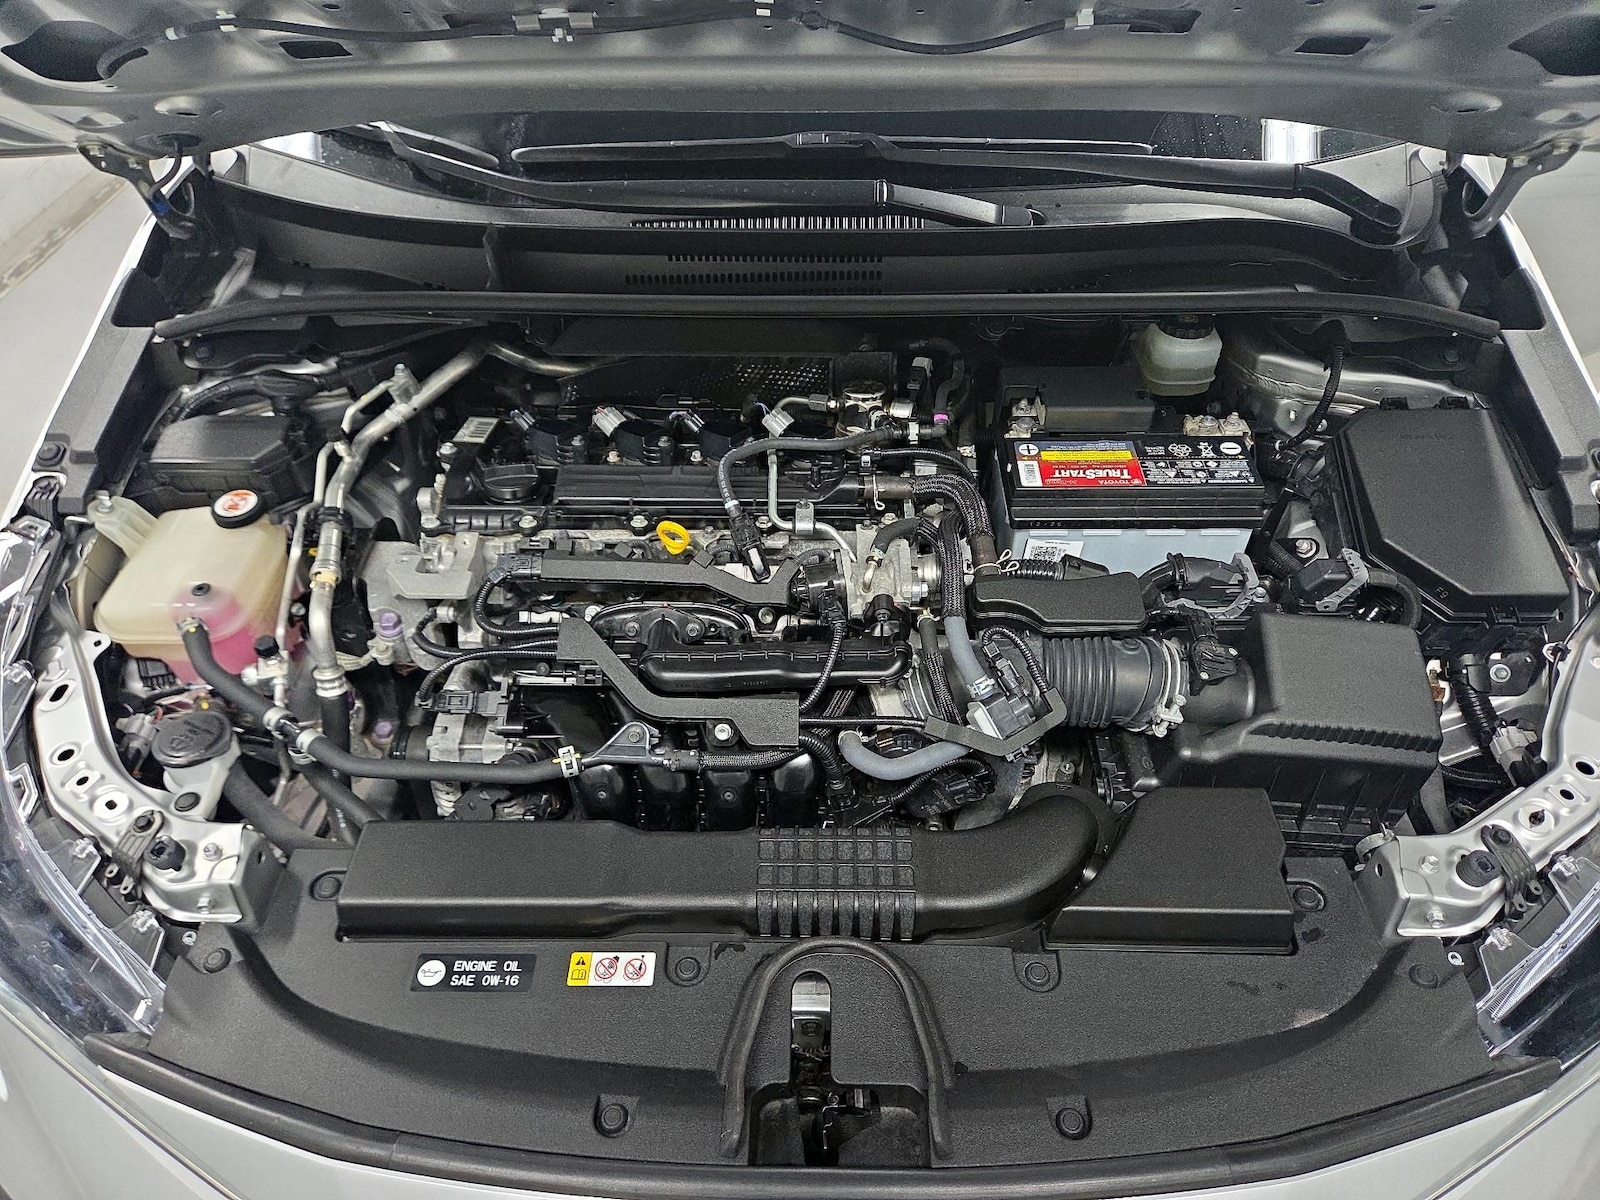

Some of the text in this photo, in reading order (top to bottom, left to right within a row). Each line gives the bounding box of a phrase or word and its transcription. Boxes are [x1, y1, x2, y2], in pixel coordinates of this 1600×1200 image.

[453, 960, 521, 972] ENGINE OIL
[450, 974, 519, 986] SAE 0W-16
